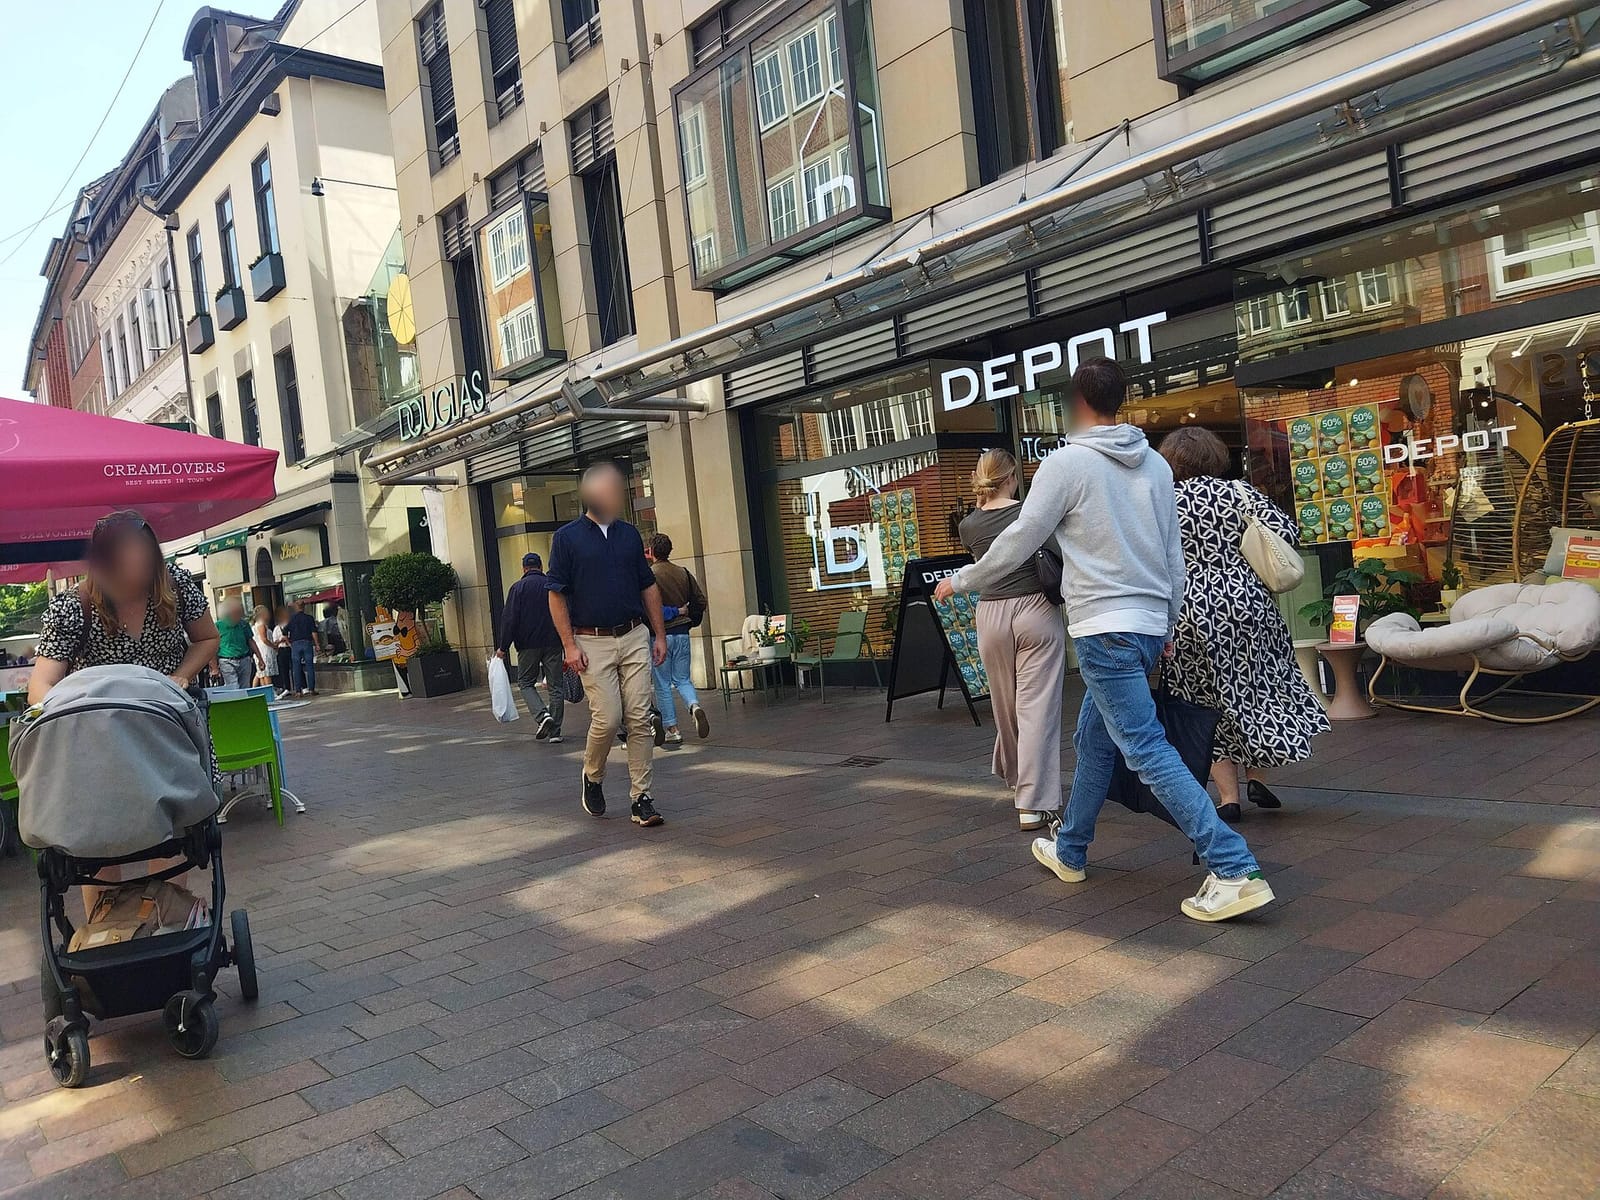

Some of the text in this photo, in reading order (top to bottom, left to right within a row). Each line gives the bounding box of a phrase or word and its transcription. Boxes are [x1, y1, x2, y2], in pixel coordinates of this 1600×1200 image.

[940, 311, 1167, 412] DEPOT
[398, 369, 485, 441] DOUGLAS
[1322, 417, 1342, 428] 50%
[1353, 411, 1373, 423] 50%
[1293, 423, 1311, 434] 50%
[1383, 425, 1517, 464] DEPOT
[1327, 461, 1347, 471] 50%
[1357, 456, 1377, 467] 50%
[103, 461, 226, 477] CREAMLOVERS
[1297, 465, 1316, 475] 50%
[1331, 504, 1351, 514] 50%
[1362, 500, 1383, 511] 50%
[1301, 507, 1320, 518] 50%
[922, 567, 961, 584] DEP
